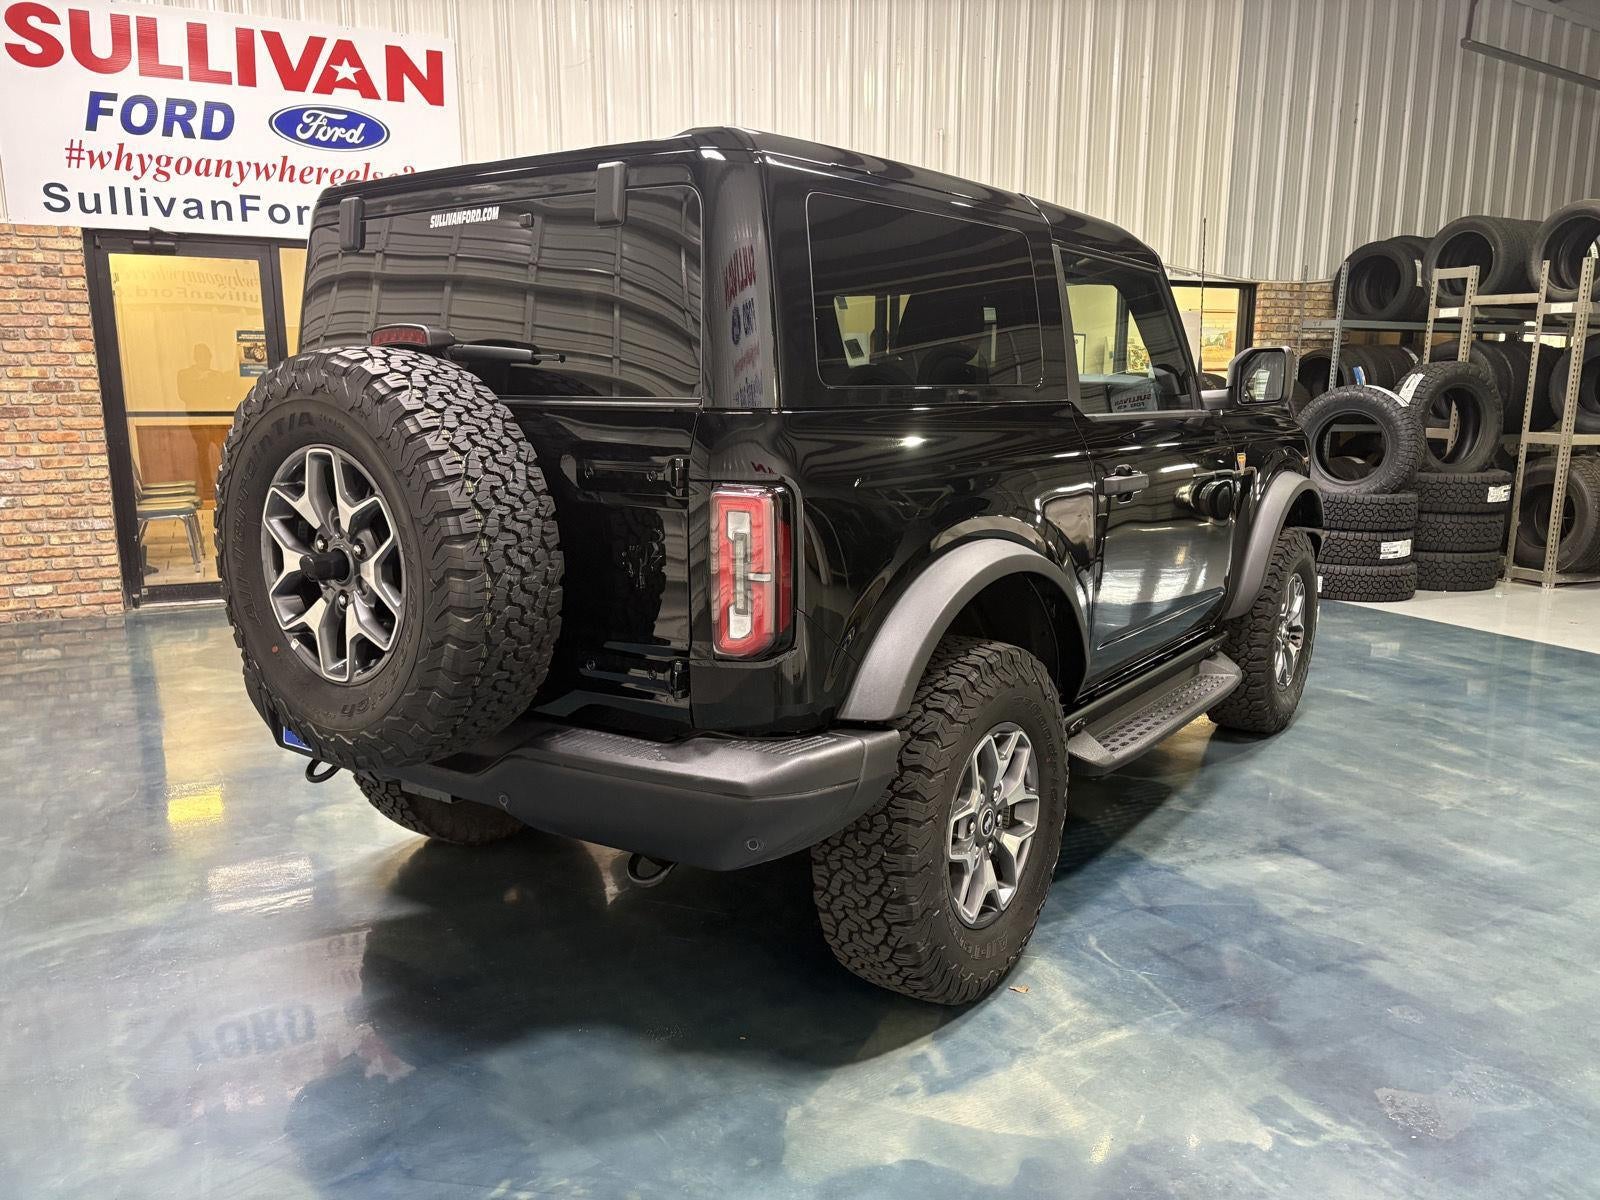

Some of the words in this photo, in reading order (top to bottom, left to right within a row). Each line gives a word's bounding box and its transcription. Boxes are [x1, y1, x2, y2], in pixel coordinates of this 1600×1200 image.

[4, 2, 445, 107] SULLIVAN
[85, 91, 235, 141] FORD
[65, 139, 416, 188] #whygoanywhereel
[430, 206, 500, 229] SULLIVANFORD.COM
